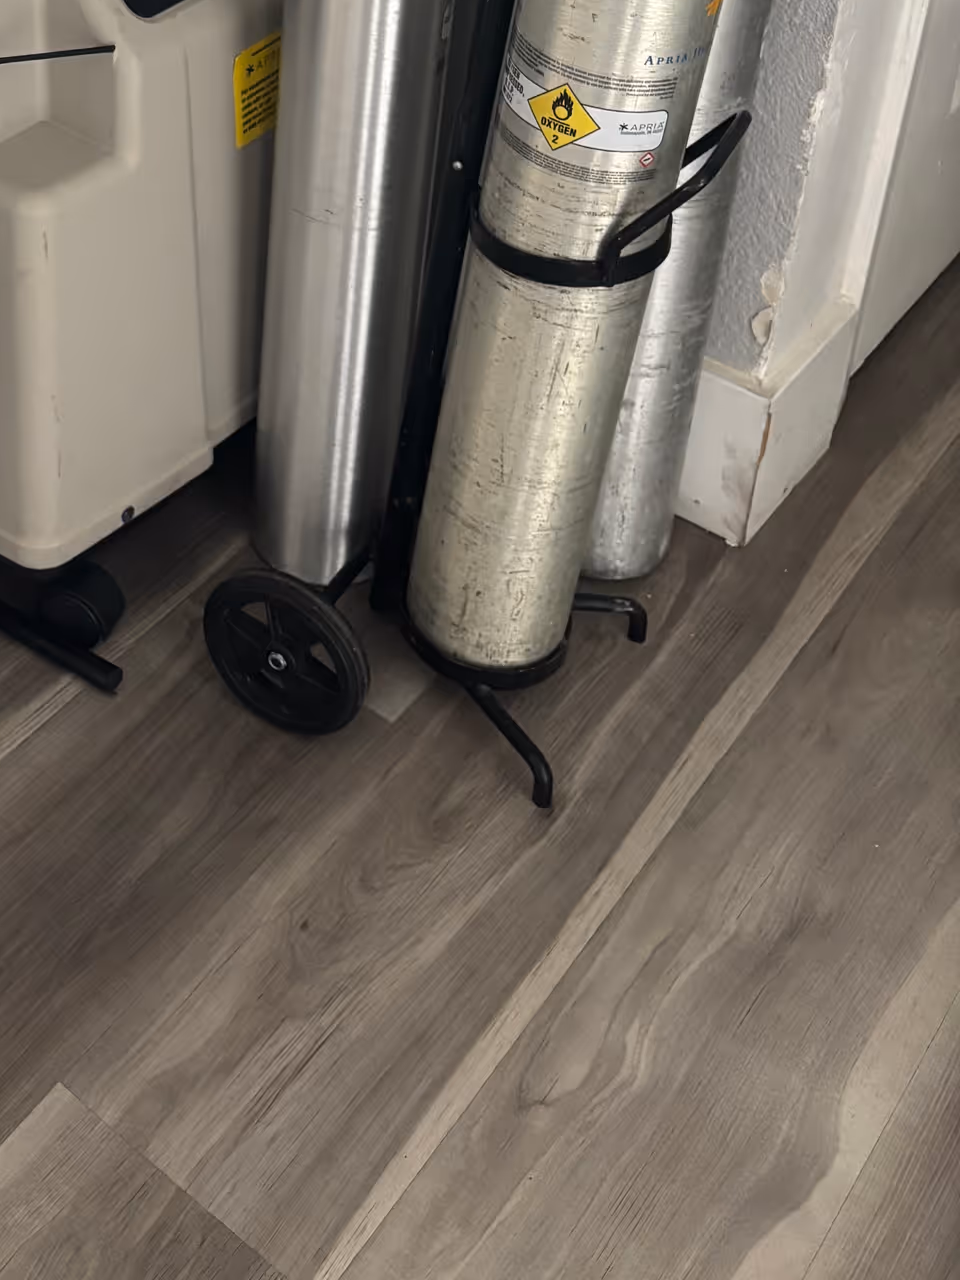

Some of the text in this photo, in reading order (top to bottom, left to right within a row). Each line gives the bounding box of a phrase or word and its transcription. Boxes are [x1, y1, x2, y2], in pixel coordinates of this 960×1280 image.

[644, 55, 688, 66] APRIA
[541, 116, 577, 138] OXYGEN
[627, 122, 664, 131] APRIA
[551, 134, 559, 144] 2
